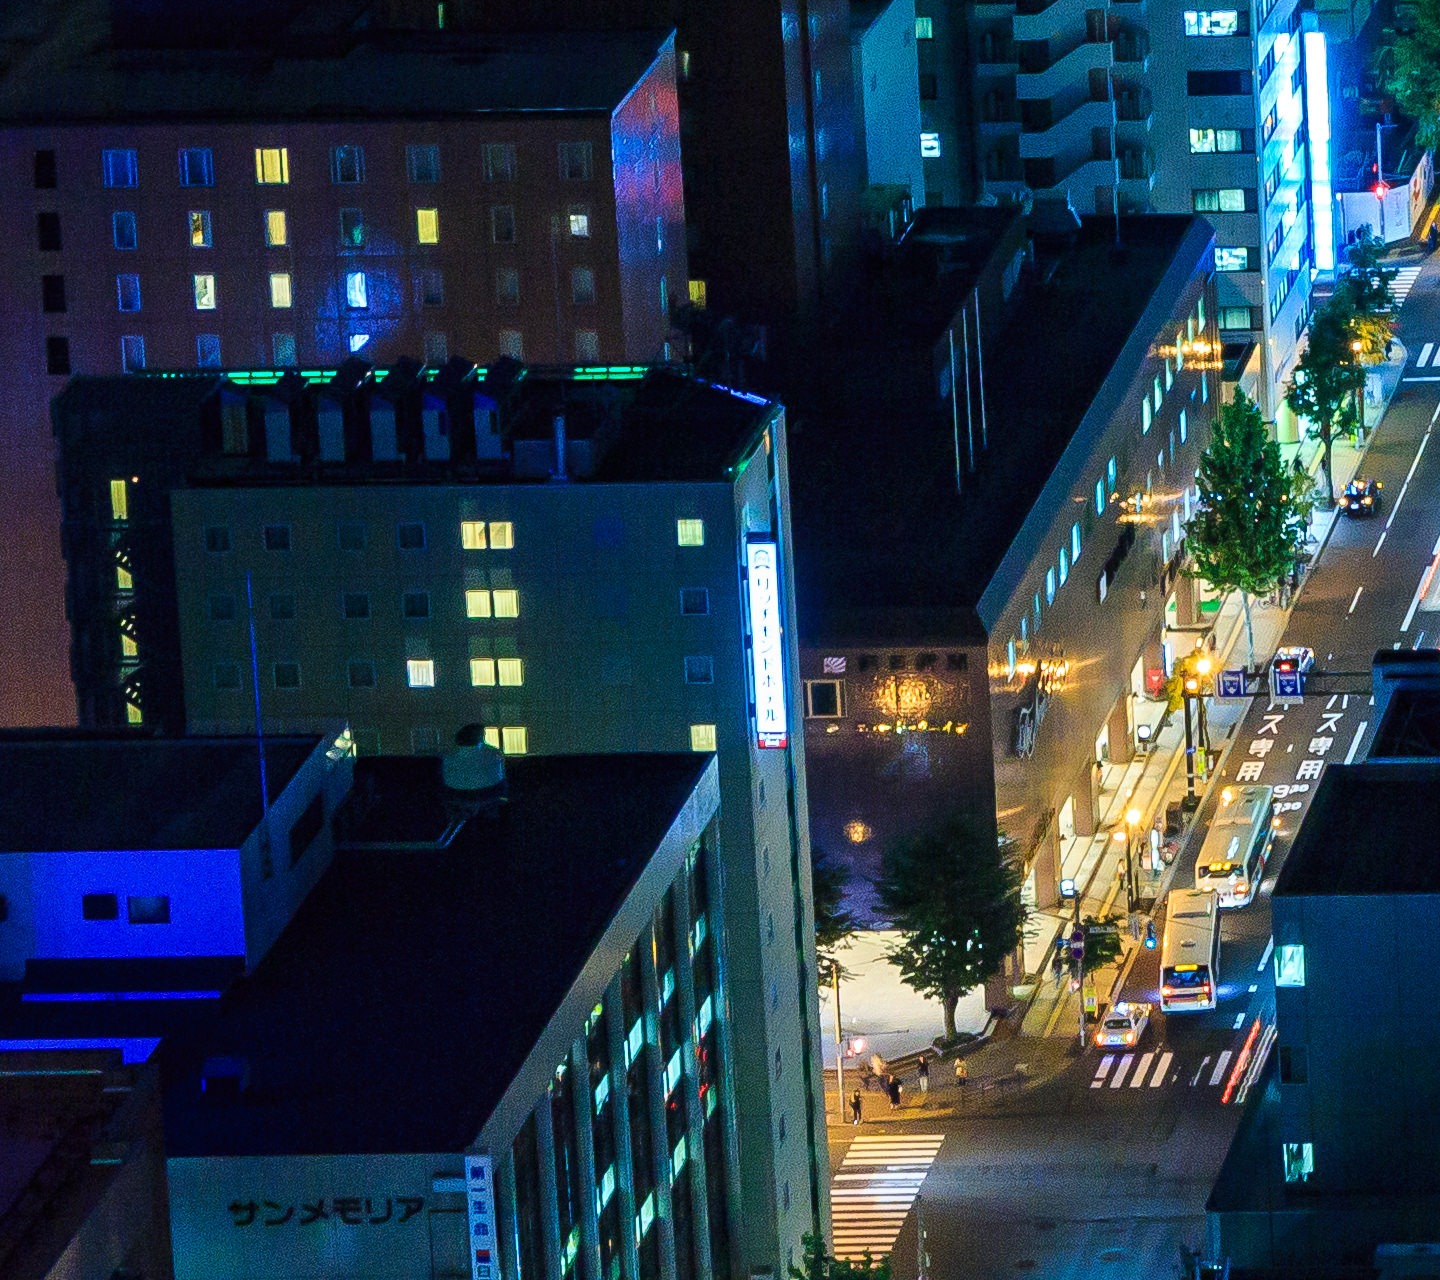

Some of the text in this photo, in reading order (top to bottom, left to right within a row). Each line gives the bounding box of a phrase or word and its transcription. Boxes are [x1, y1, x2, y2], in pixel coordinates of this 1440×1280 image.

[226, 1197, 428, 1228] サンメモリア
